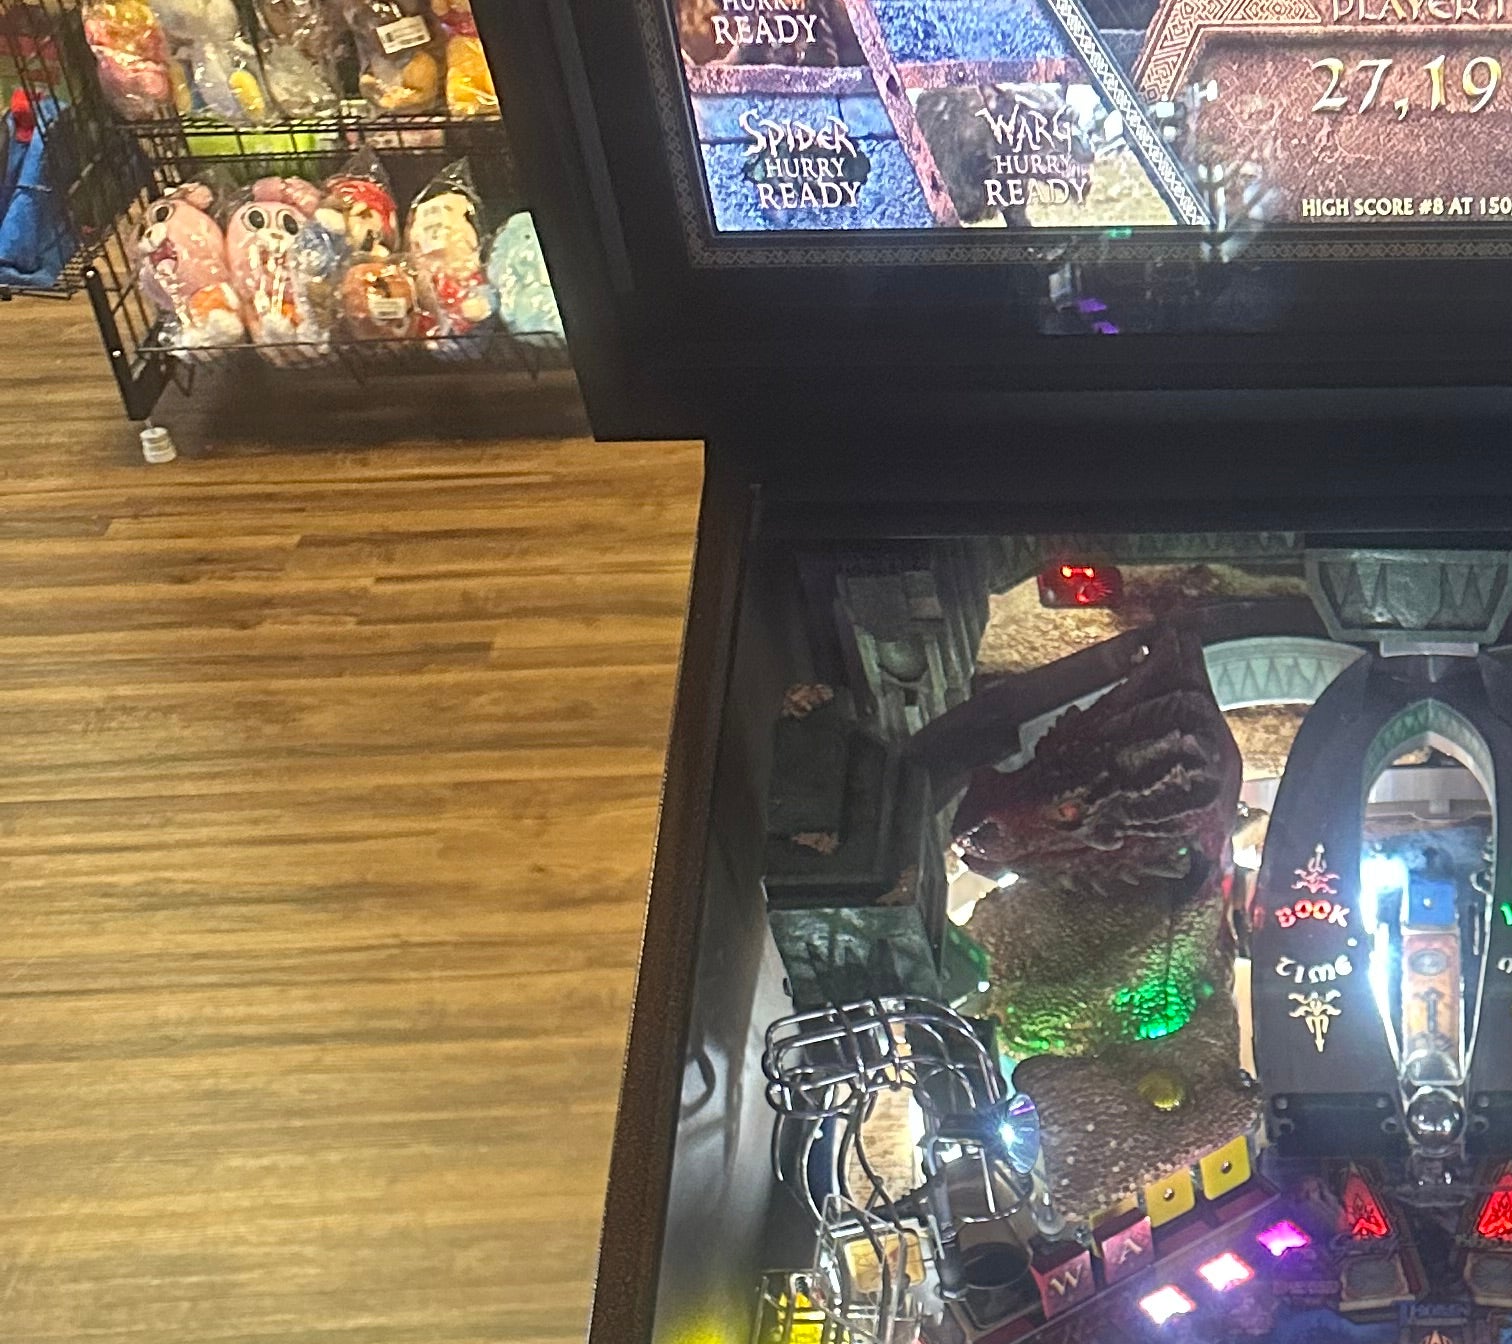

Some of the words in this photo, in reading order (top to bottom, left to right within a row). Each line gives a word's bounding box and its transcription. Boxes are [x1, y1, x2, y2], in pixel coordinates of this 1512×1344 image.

[714, 14, 818, 46] READY
[738, 110, 857, 158] SPIDER
[975, 105, 1073, 154] WARG
[764, 156, 846, 179] HURRY
[757, 181, 861, 210] READY
[984, 178, 1090, 207] READY
[1302, 197, 1350, 217] HIGH
[1354, 197, 1414, 217] SCORE
[1418, 196, 1445, 216] #8
[1449, 197, 1474, 215] AT
[1275, 898, 1352, 928] BOOK
[1050, 1264, 1083, 1296] W
[1118, 1238, 1144, 1265] A
